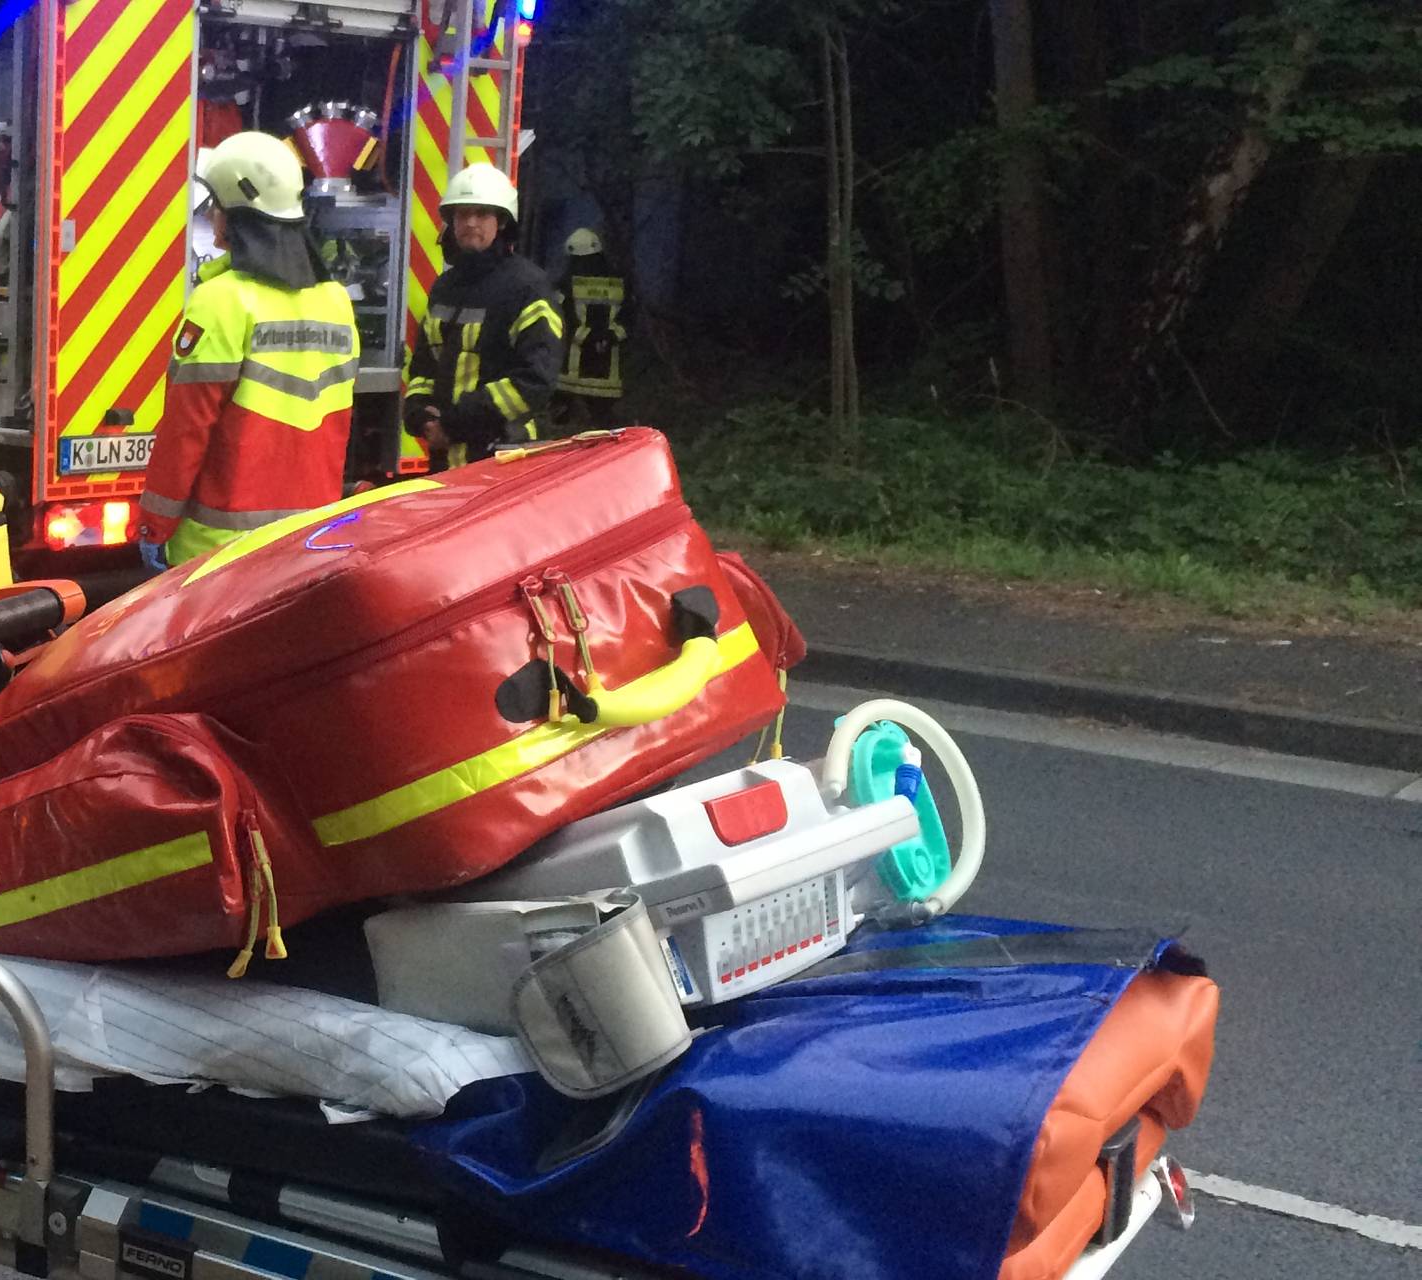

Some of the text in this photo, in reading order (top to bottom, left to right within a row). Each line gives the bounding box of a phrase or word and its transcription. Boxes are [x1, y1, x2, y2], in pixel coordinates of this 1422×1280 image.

[72, 442, 85, 466] K
[96, 441, 121, 465] LN
[126, 1247, 183, 1274] FERNO
